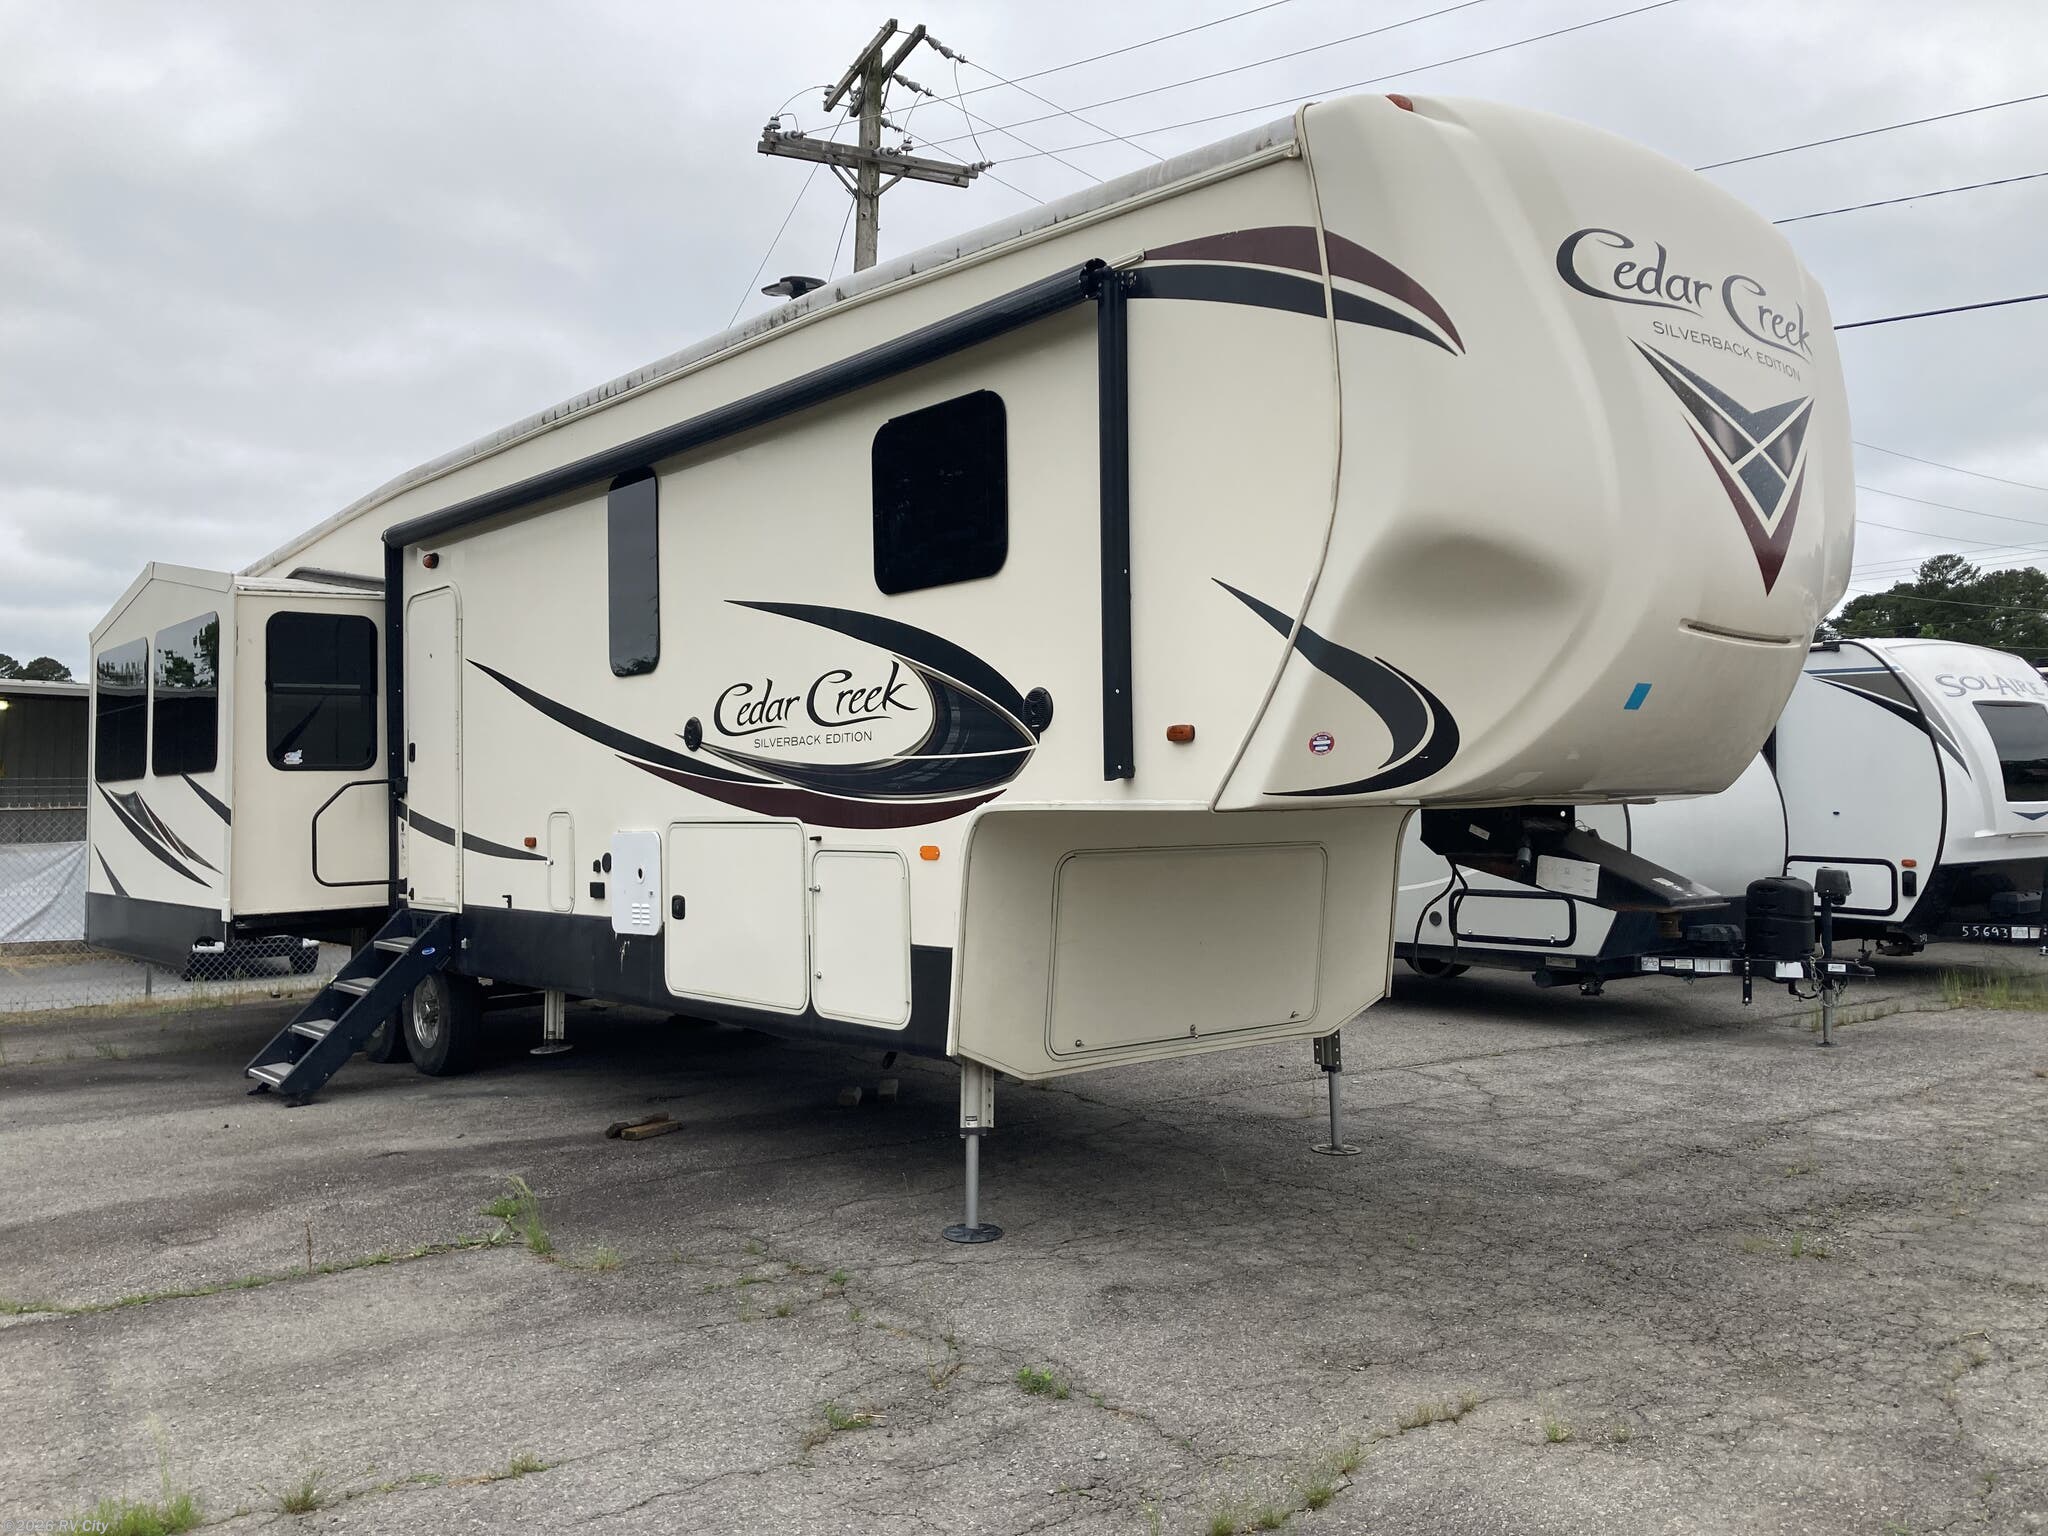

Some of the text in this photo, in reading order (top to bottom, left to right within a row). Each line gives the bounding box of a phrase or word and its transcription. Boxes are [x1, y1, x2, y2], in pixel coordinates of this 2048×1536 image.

[1556, 228, 1813, 363] Cedar Creek
[1652, 320, 1801, 382] SILVERBACK EDITION
[713, 660, 919, 736] Cedar Creek
[754, 731, 873, 748] SILVERBACK EDITION
[1962, 925, 2009, 938] 55693
